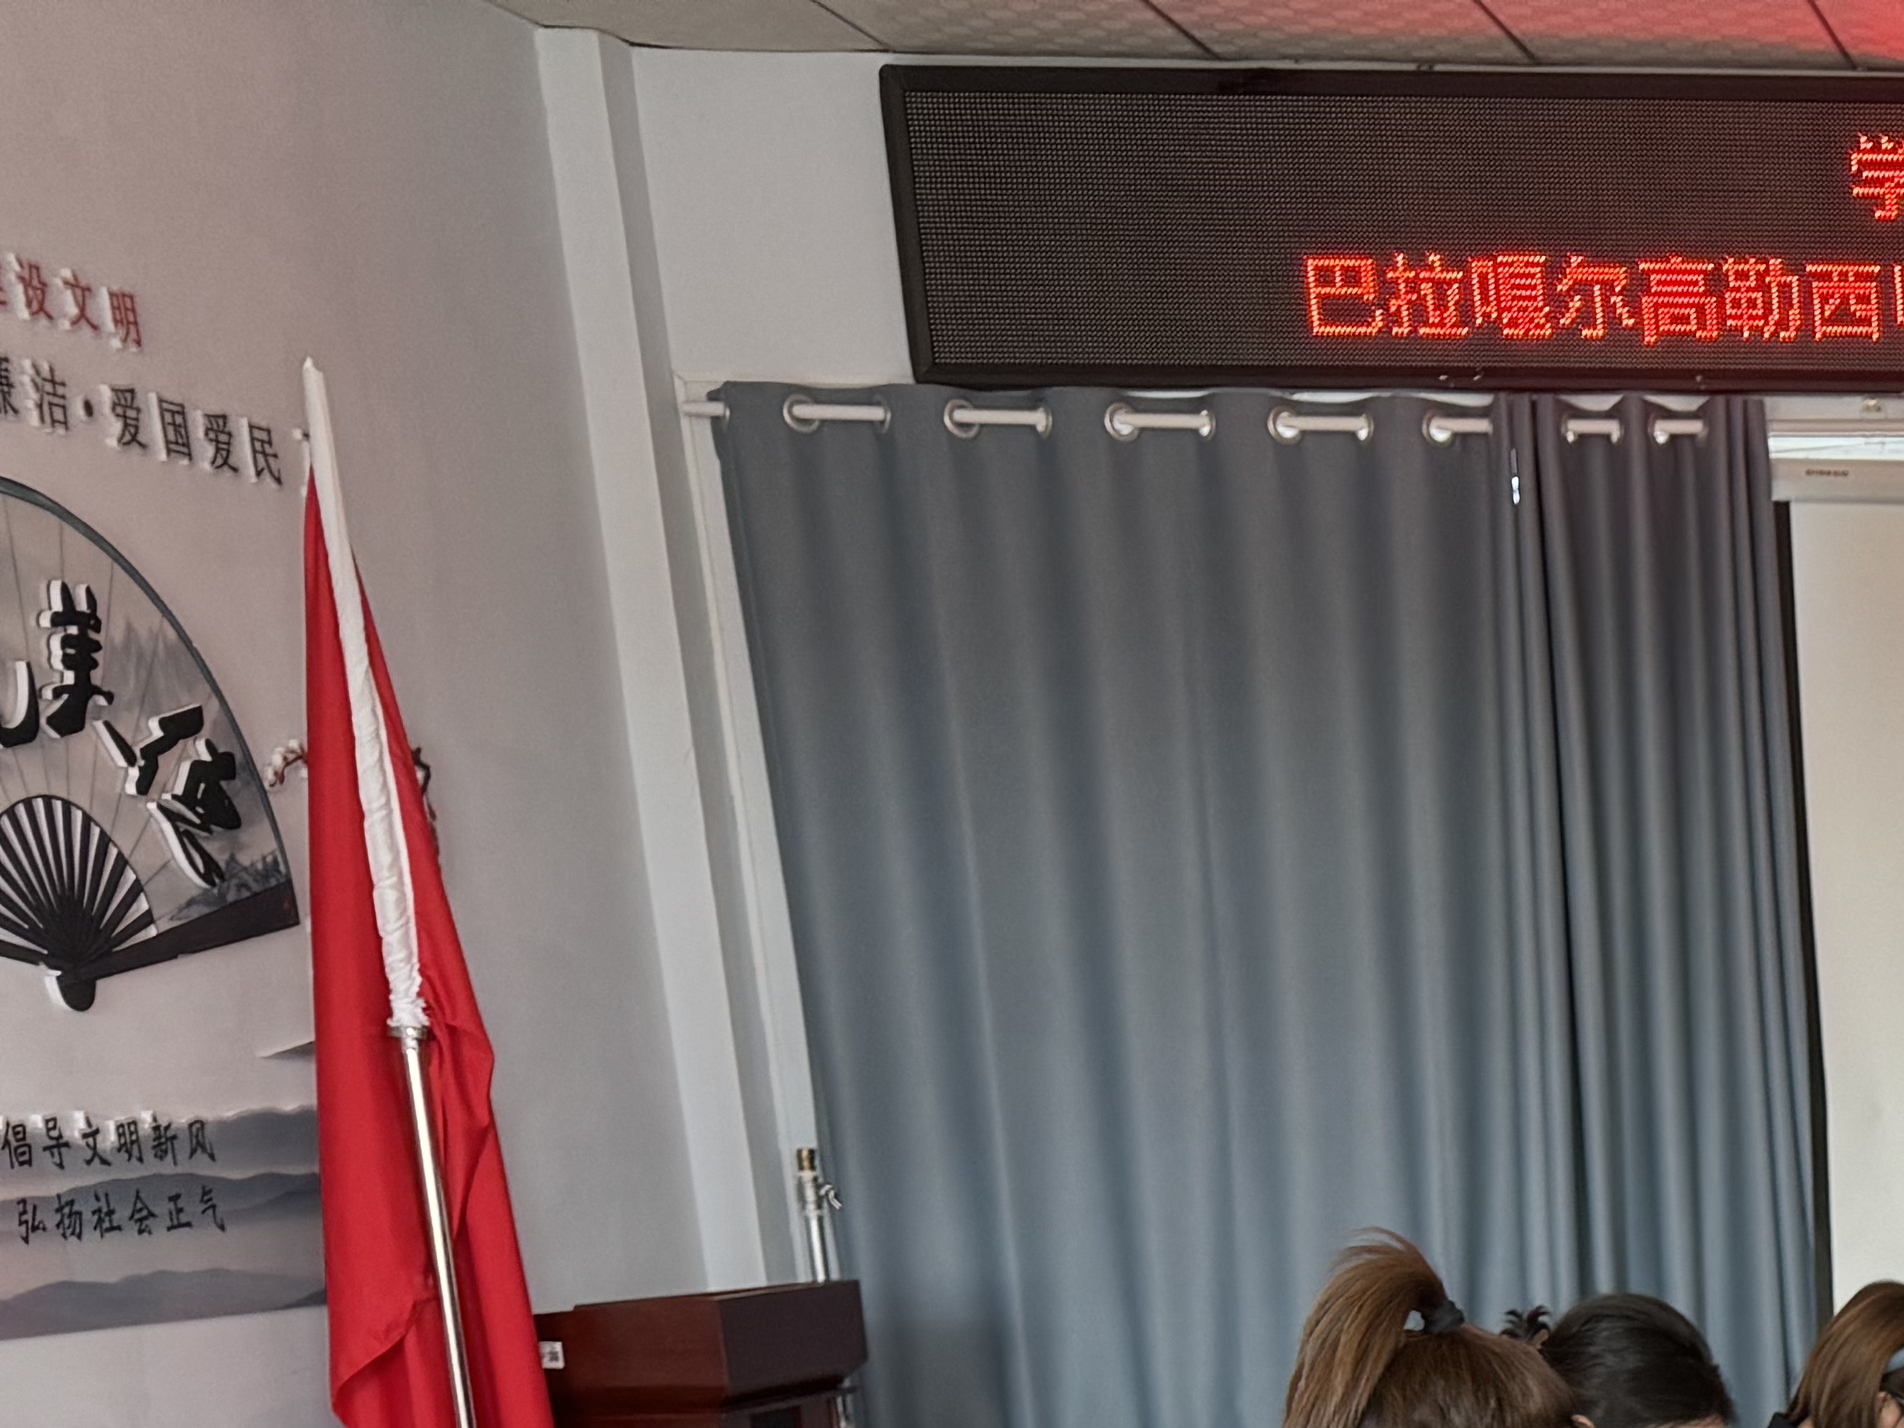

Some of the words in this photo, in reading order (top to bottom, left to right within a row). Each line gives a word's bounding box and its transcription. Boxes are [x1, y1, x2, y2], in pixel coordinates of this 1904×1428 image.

[0, 253, 141, 348] 设文明
[1, 1116, 216, 1171] 倡导文明新风
[17, 1186, 226, 1245] 弘扬社会正气
